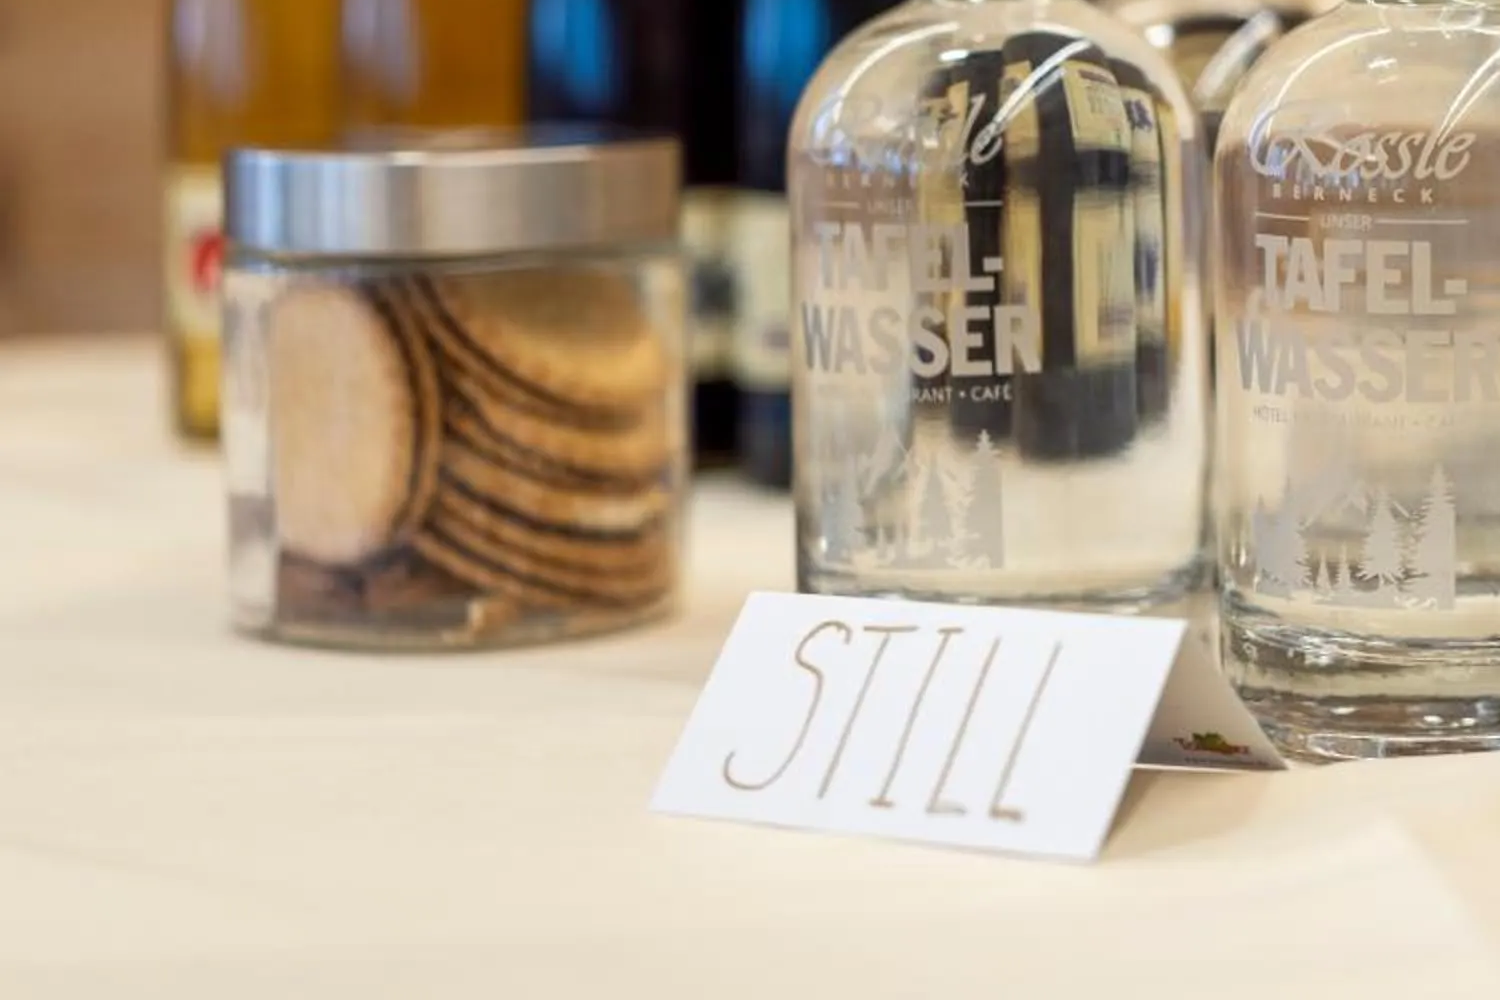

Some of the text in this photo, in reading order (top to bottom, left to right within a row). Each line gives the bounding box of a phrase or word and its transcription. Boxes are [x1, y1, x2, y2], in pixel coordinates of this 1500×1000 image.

[1272, 183, 1433, 204] BERNECK
[1254, 232, 1468, 315] TAFEL-
[800, 300, 1043, 378] WASSER
[1236, 315, 1500, 403] WASSER
[723, 620, 1062, 822] STILL
